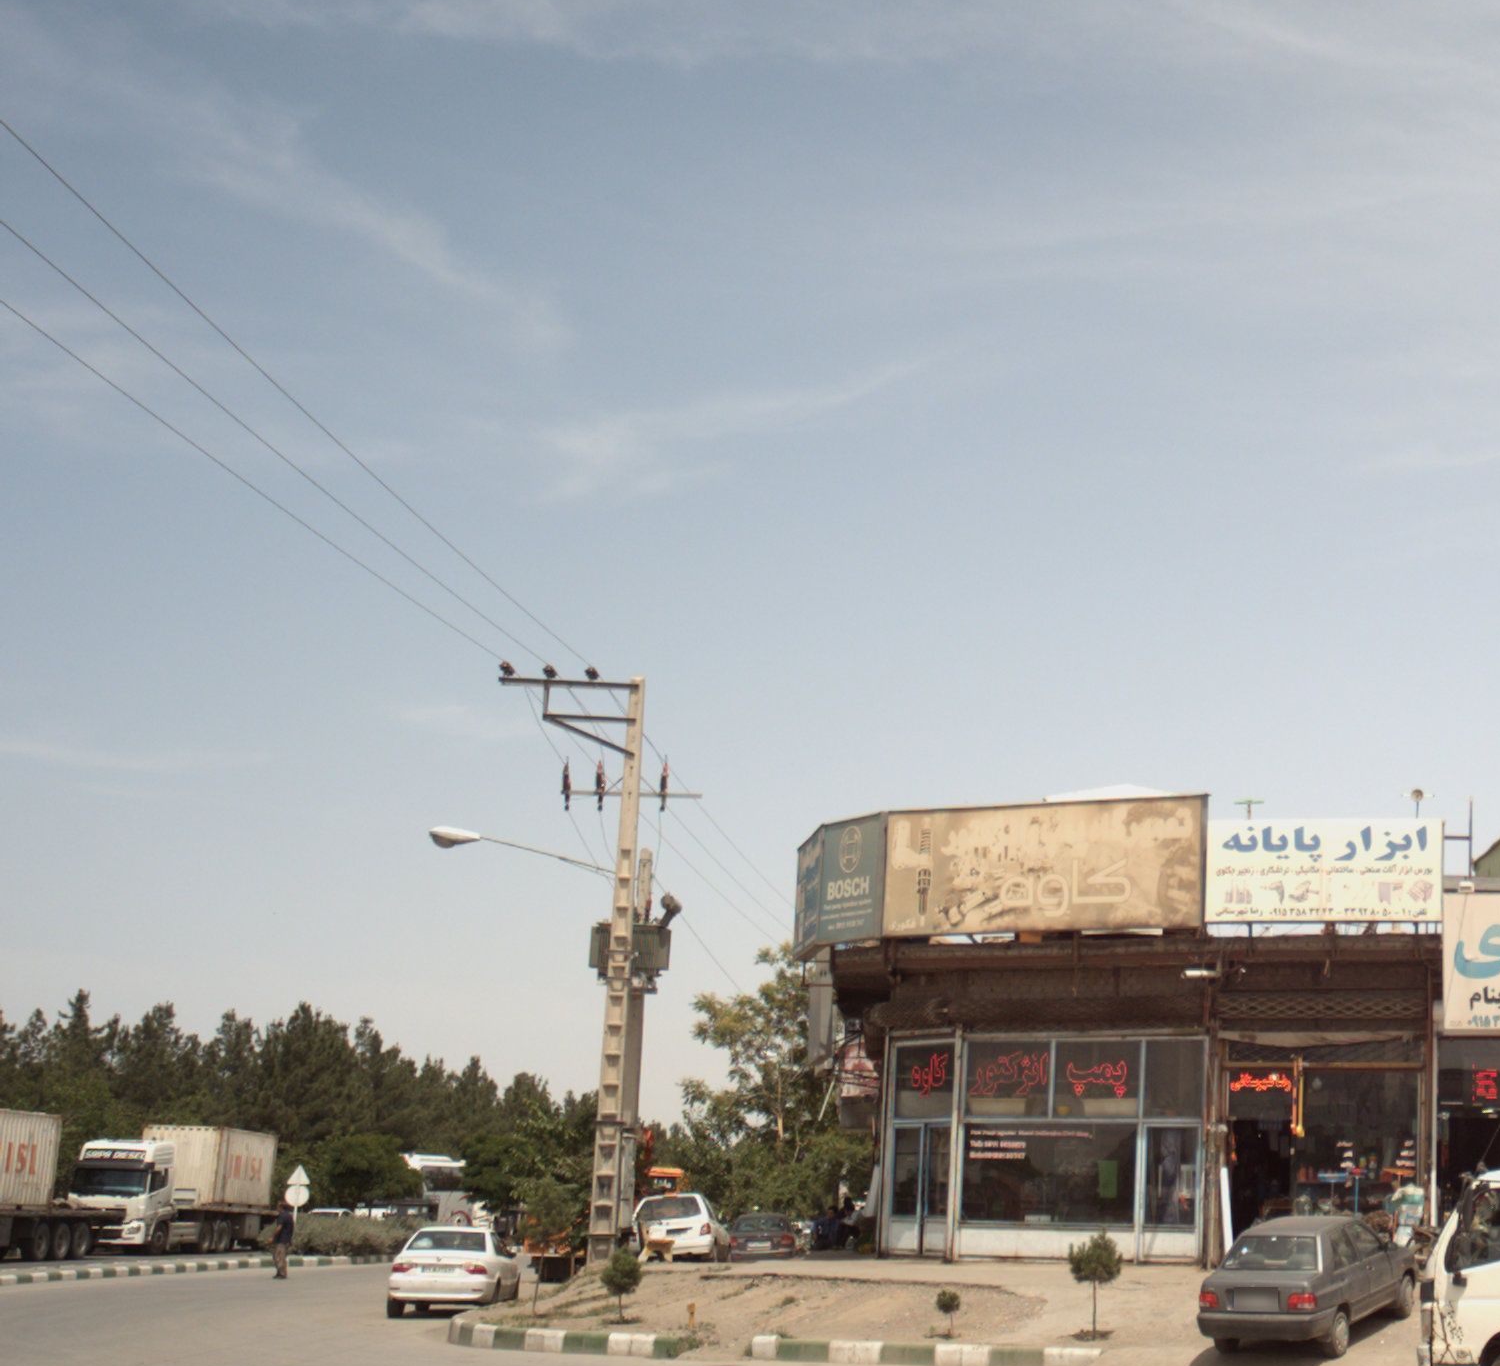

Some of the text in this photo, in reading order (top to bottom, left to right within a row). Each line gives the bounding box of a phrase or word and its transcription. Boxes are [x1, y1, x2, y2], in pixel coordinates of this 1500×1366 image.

[1221, 825, 1428, 863] ابزار پایانه
[827, 876, 870, 901] BOSCH
[999, 857, 1132, 918] کاوه
[969, 1050, 1050, 1096] انژکتور
[1066, 1059, 1128, 1099] پمپ
[0, 1140, 38, 1176] ISL
